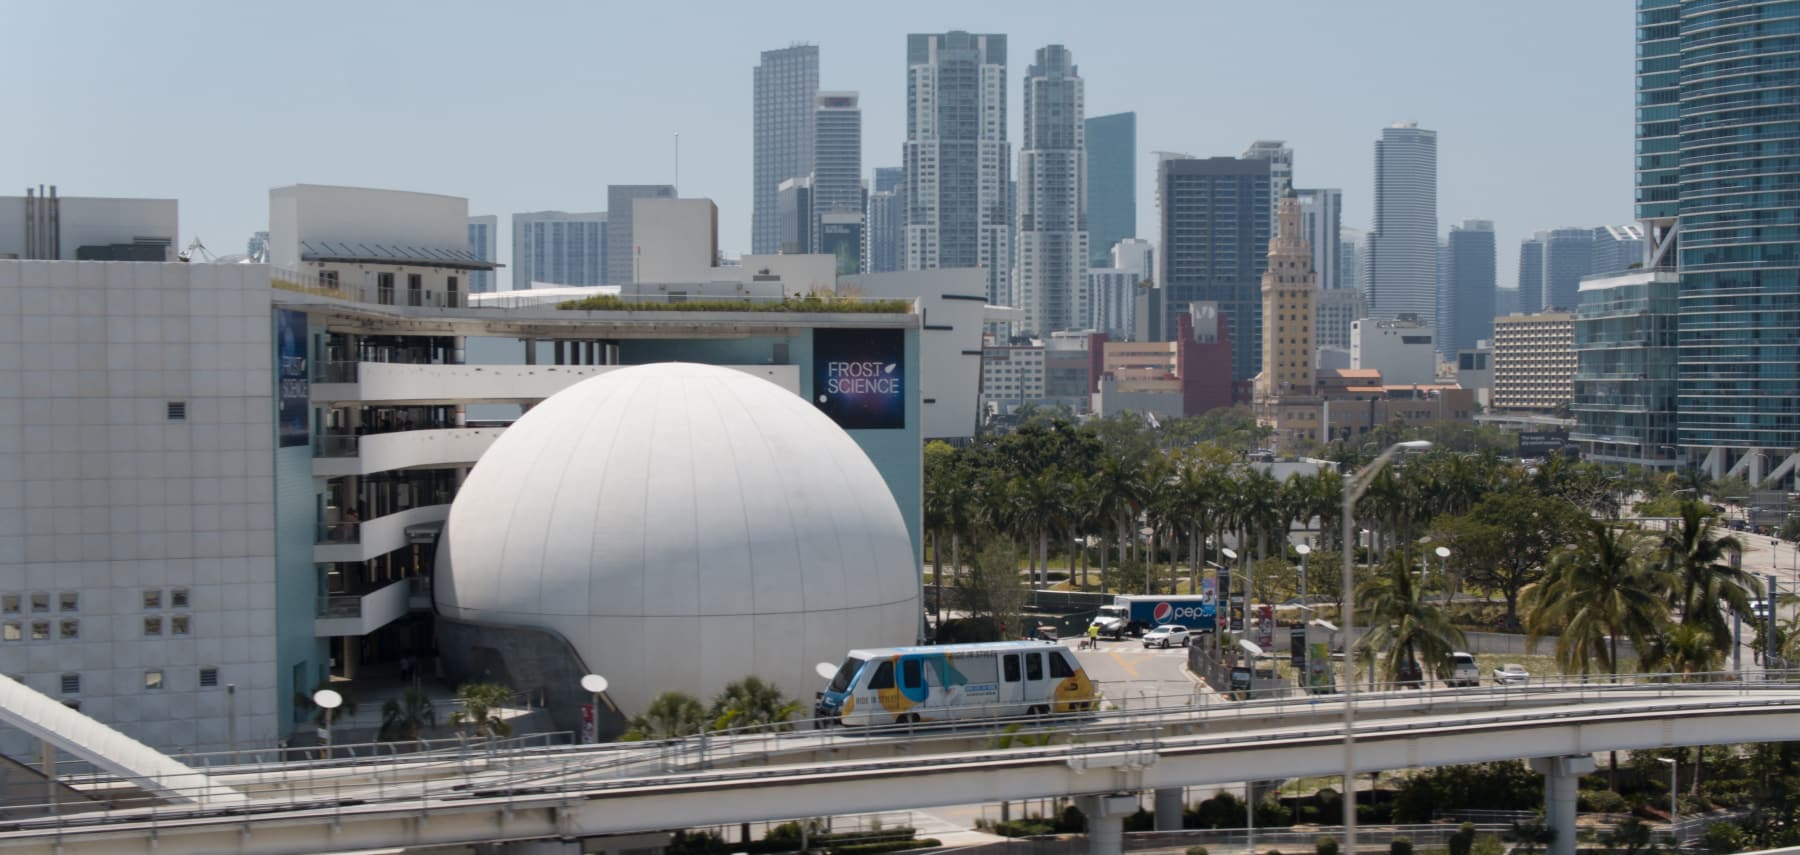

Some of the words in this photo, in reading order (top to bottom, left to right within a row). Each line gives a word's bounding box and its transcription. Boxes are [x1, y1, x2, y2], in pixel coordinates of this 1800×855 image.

[828, 361, 882, 377] FROST
[827, 378, 899, 394] SCIENCE
[1174, 606, 1213, 621] pep
